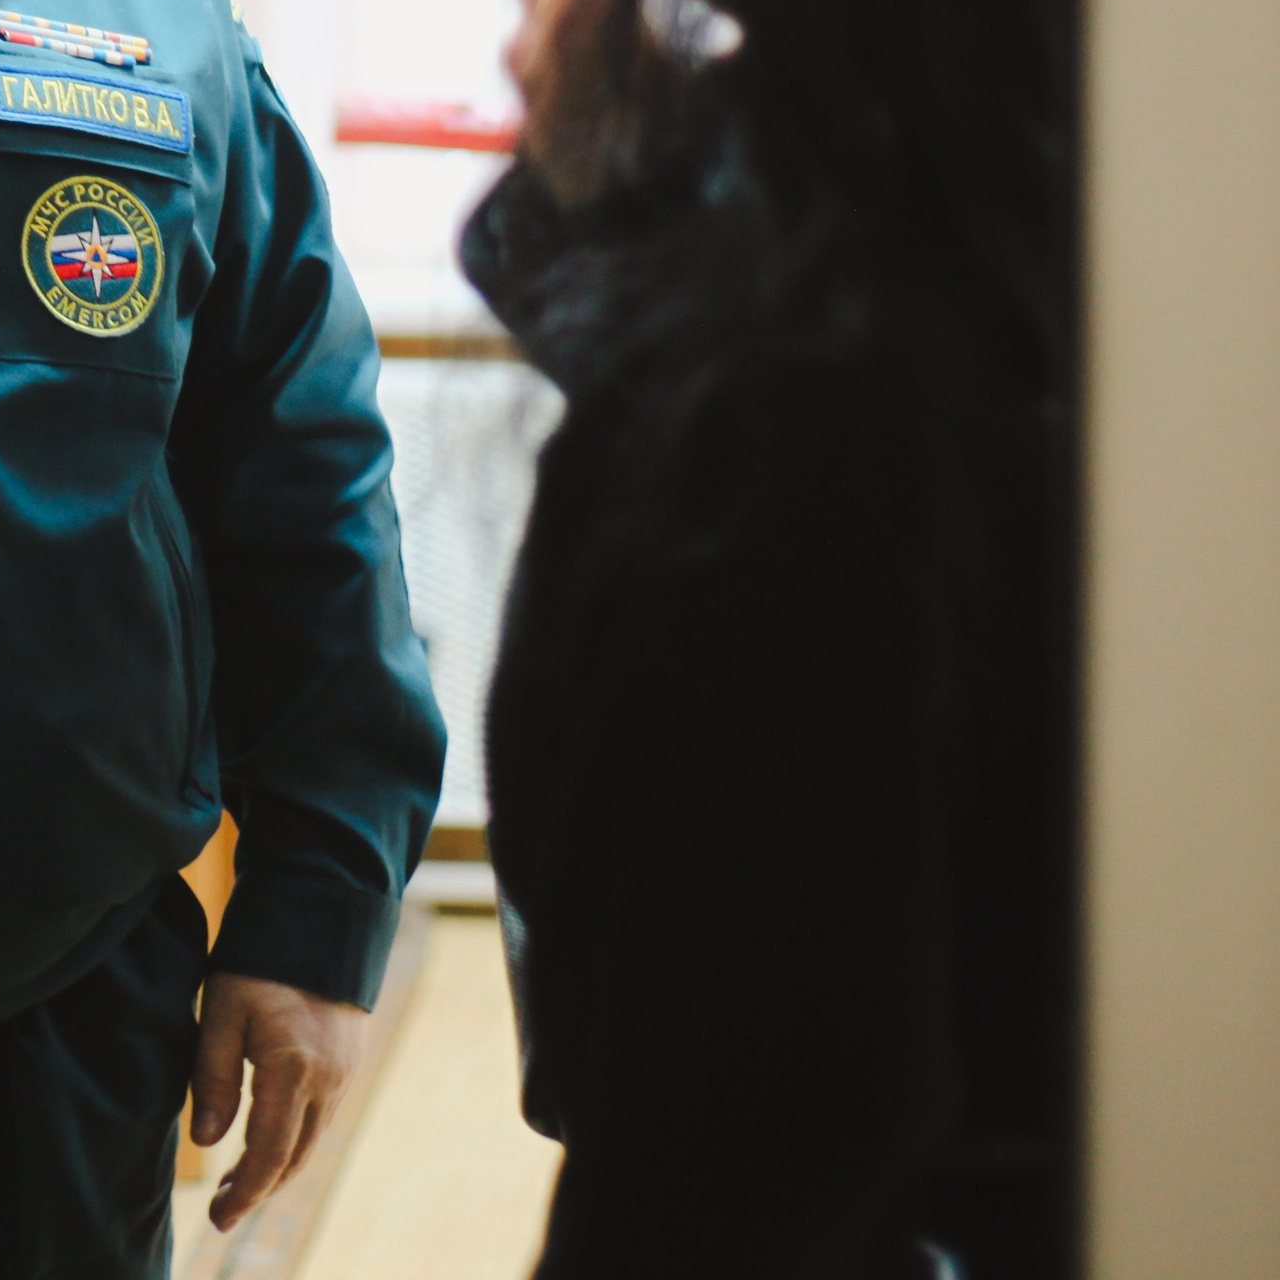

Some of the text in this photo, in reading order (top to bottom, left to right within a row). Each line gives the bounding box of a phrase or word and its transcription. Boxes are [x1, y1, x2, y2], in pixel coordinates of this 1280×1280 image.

[30, 183, 155, 246] МЧС РОССИИ
[46, 285, 149, 329] EMERCOM
